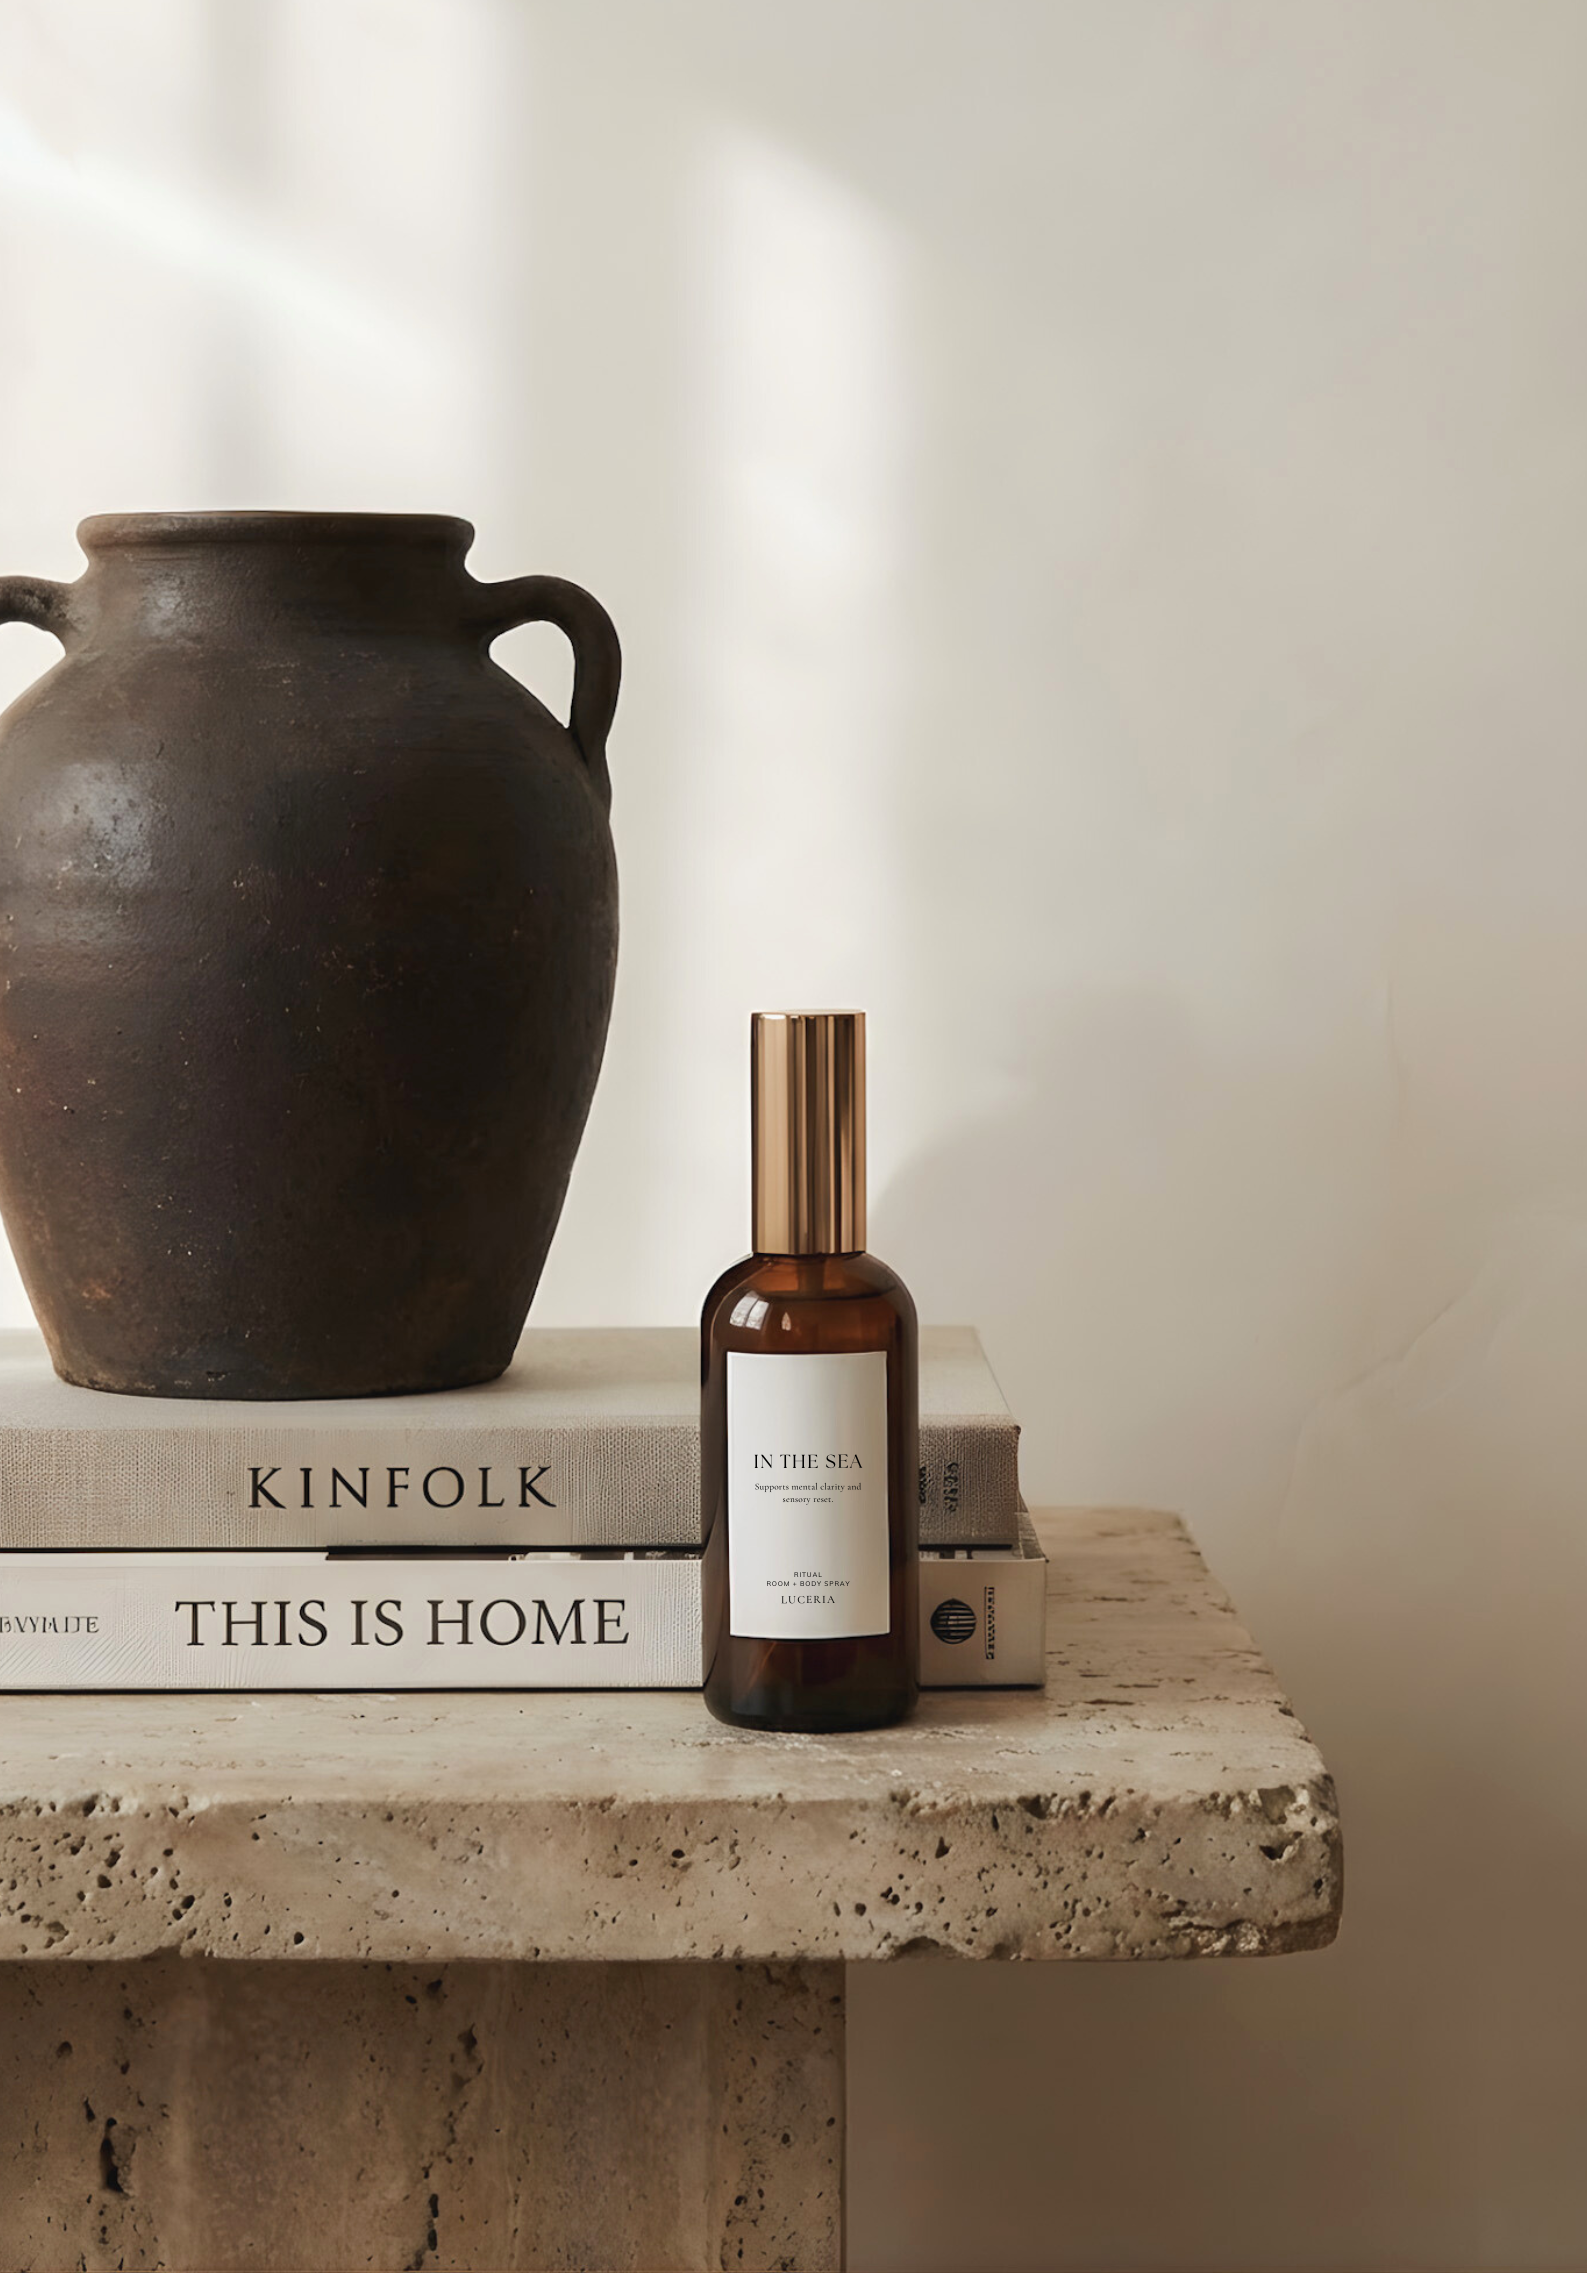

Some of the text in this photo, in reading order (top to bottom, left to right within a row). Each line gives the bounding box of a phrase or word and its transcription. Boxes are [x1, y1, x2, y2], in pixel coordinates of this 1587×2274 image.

[754, 1453, 863, 1469] IN THE SEA
[248, 1466, 557, 1509] KINFOLK
[754, 1482, 862, 1493] Supports mental clarity and
[782, 1496, 812, 1506] sensory
[781, 1595, 836, 1605] LUCERIA
[175, 1599, 630, 1647] THIS IS HOME
